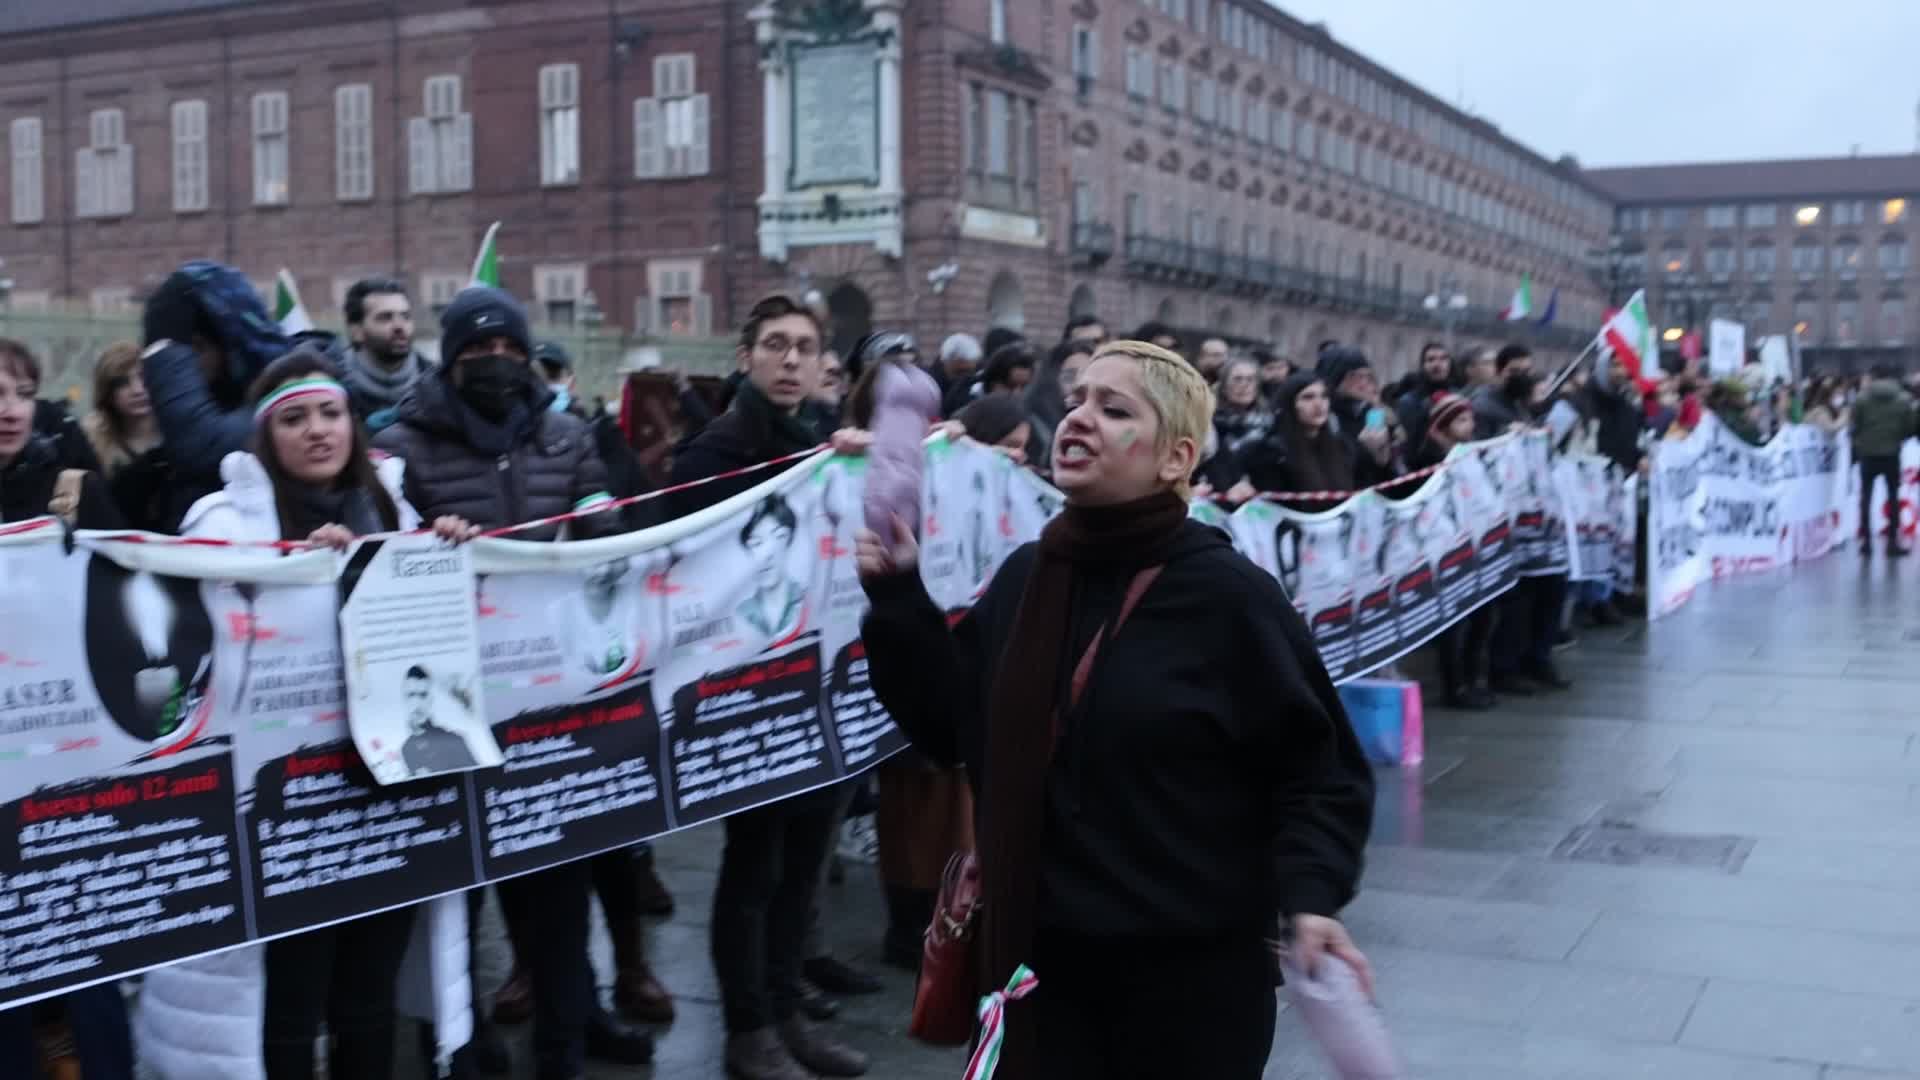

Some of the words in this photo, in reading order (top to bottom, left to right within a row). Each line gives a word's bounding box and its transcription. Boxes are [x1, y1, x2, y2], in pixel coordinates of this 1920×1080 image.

[20, 795, 93, 823] Aveva
[94, 784, 136, 806] solo
[141, 776, 169, 800] 12
[169, 767, 219, 796] anni
